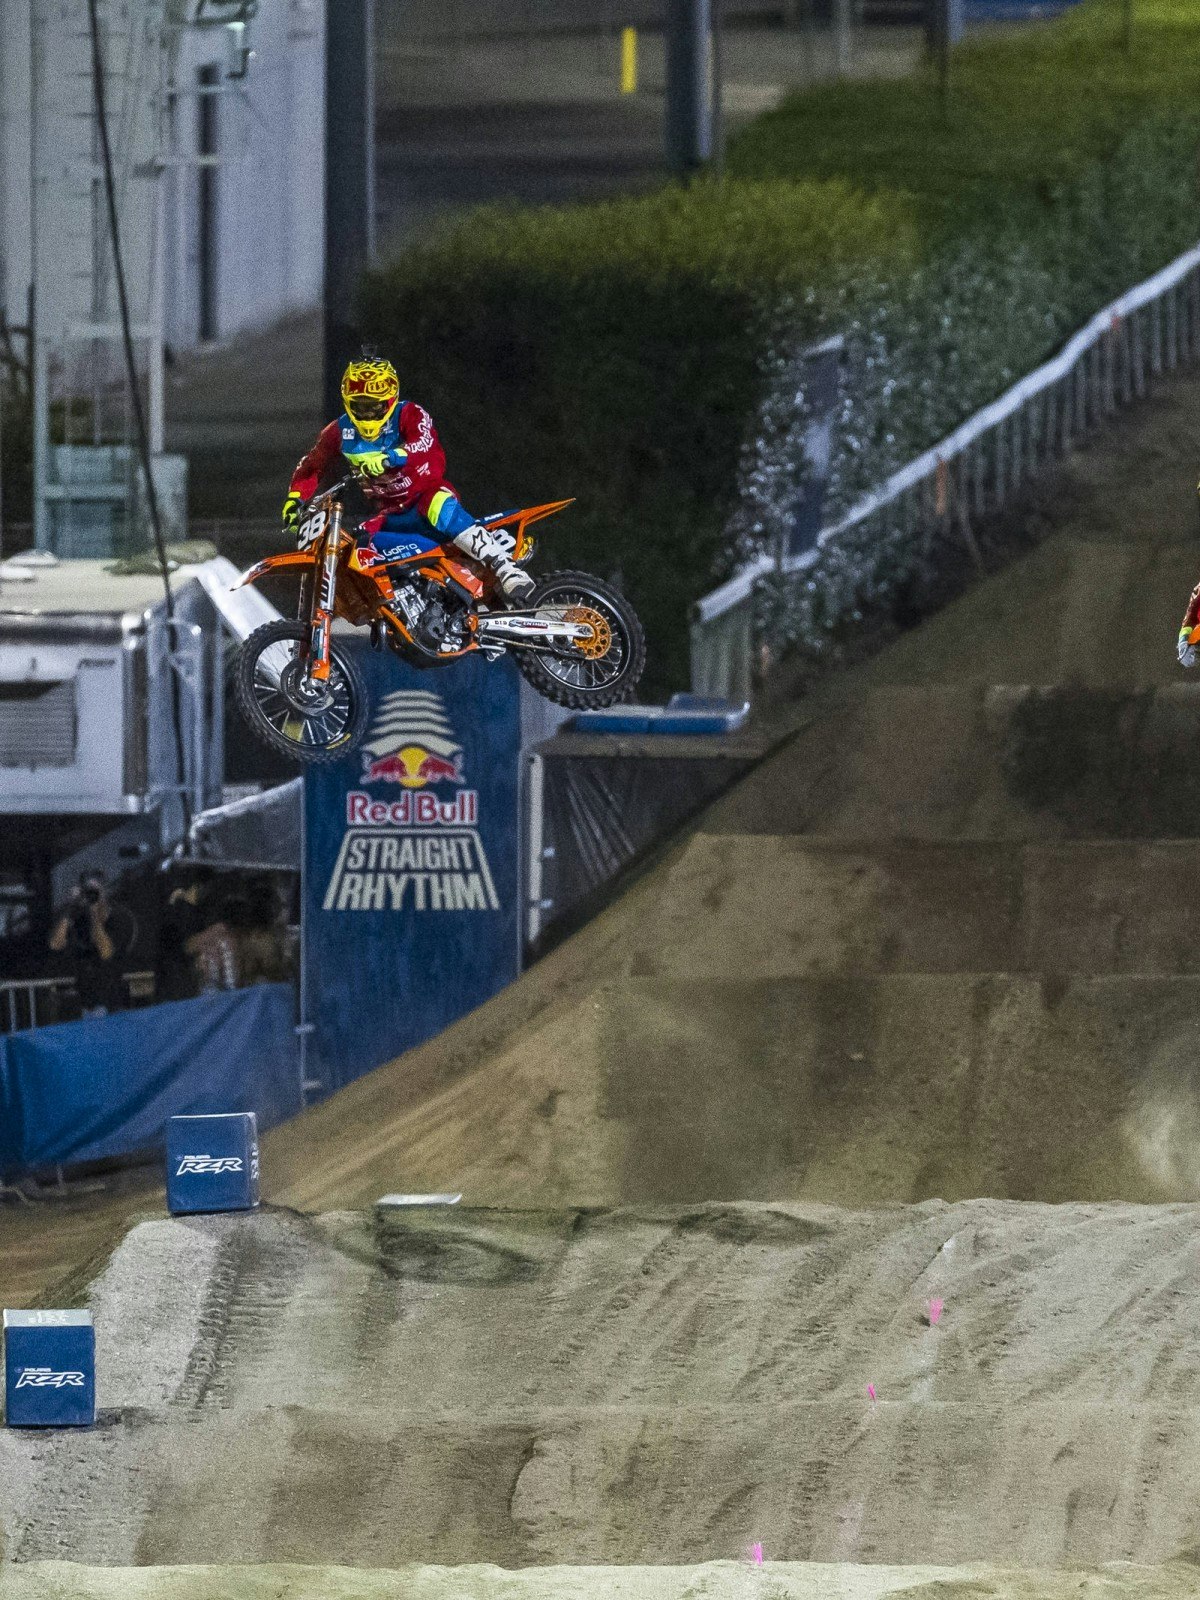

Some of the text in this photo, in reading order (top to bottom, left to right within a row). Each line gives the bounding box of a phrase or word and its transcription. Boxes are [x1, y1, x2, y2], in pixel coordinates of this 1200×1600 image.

[298, 511, 326, 551] 38
[383, 543, 418, 557] GoPro
[347, 790, 479, 825] Red Bull
[347, 837, 474, 870] STRAIGHT
[337, 873, 488, 911] RHYTHM
[176, 1157, 243, 1176] RZR
[15, 1371, 85, 1389] RZR
